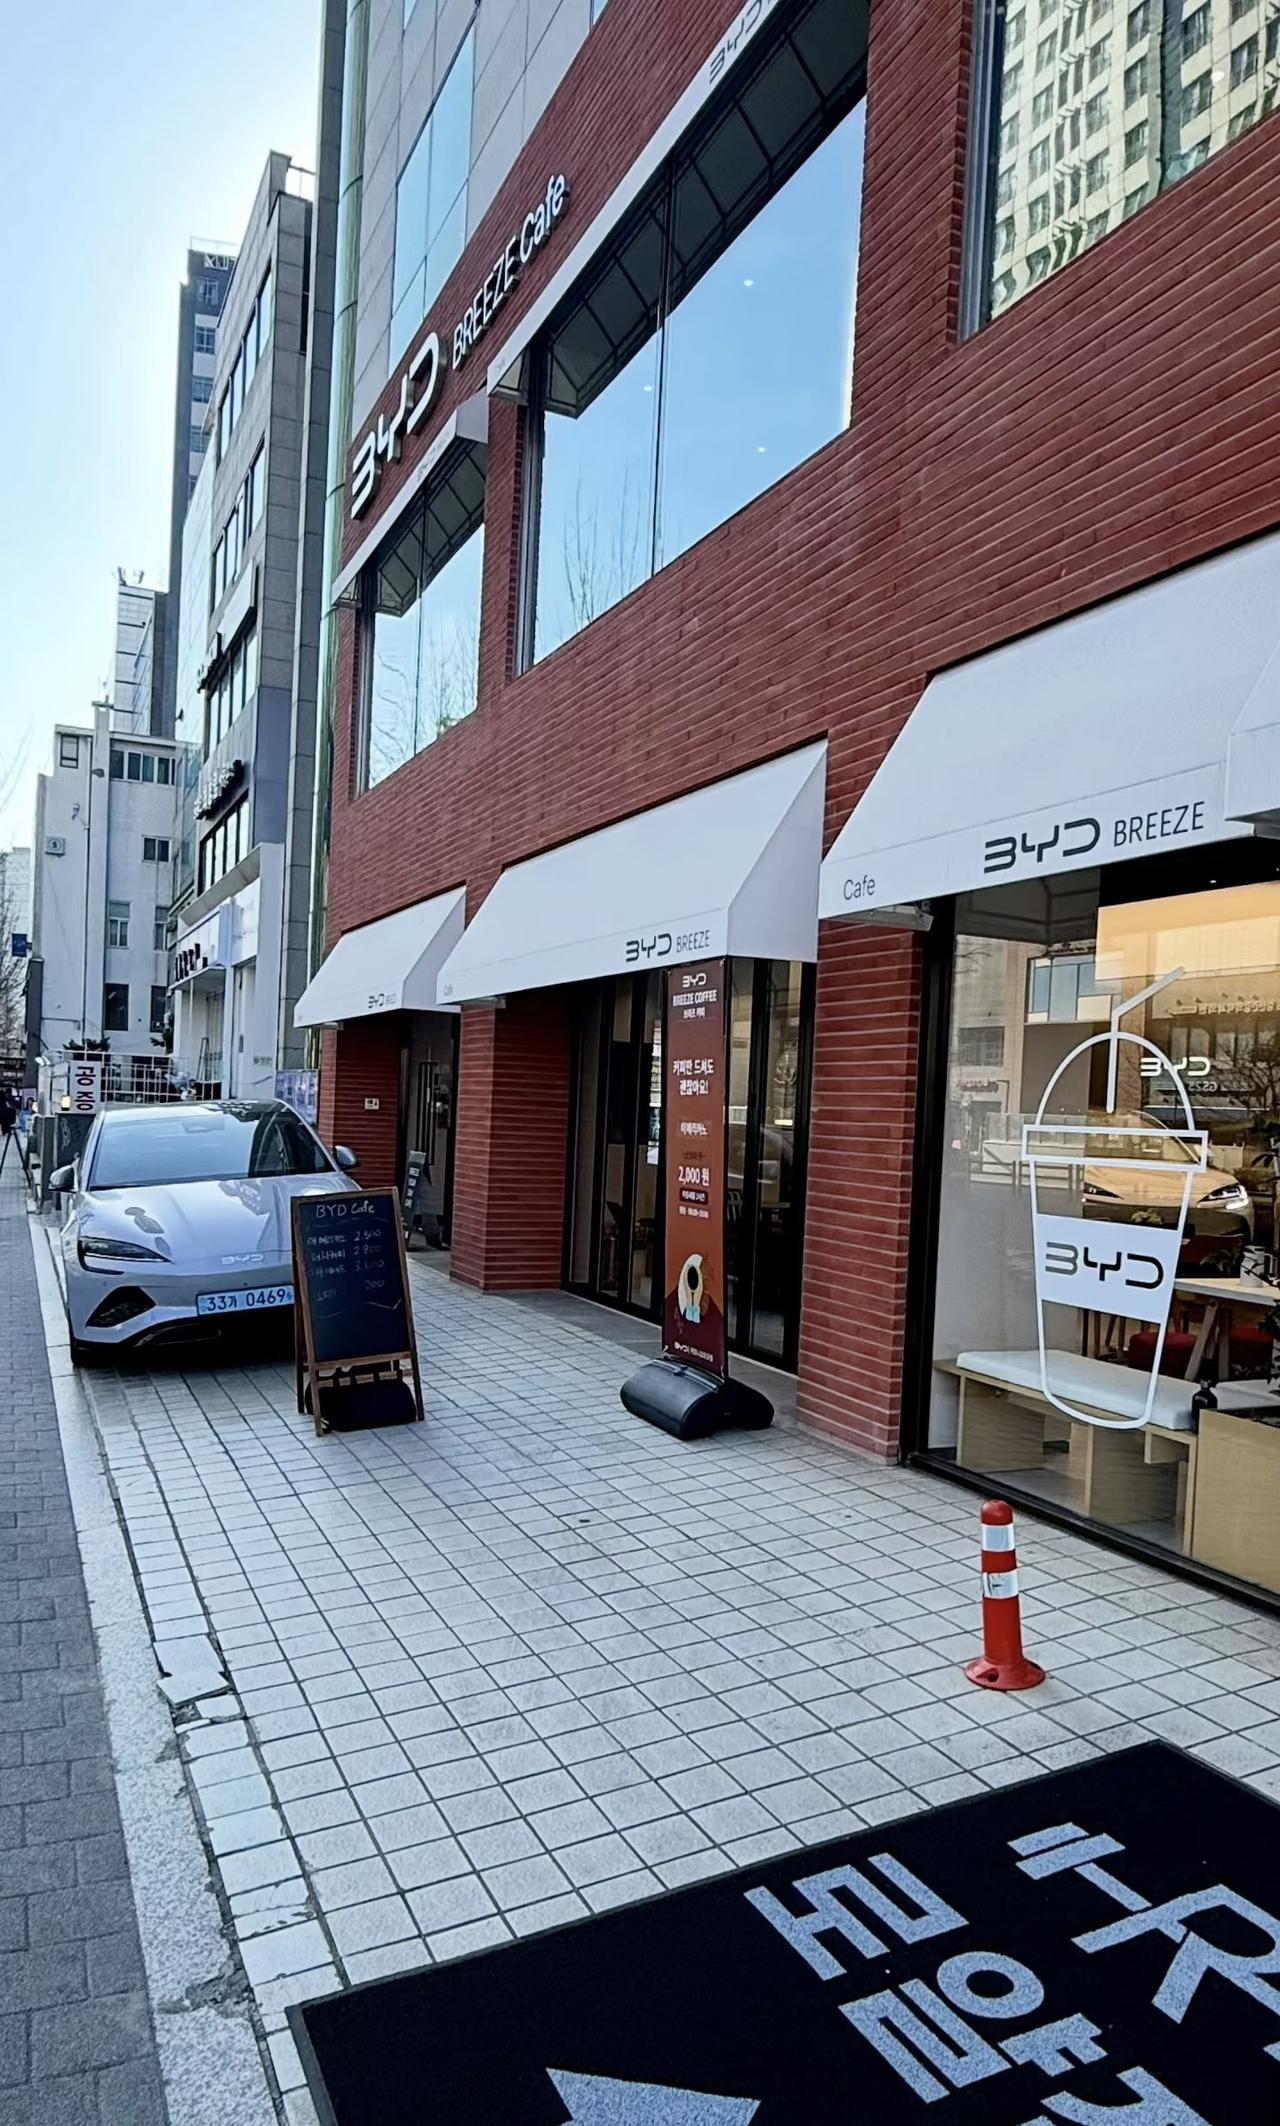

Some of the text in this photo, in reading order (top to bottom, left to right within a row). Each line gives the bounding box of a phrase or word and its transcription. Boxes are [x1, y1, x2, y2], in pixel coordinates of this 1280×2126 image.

[351, 174, 568, 519] BYD BREEZE Cafe
[843, 801, 1205, 902] Cafe BYD BREEZE
[626, 933, 673, 962] BYD
[676, 930, 711, 953] BREEZE
[682, 973, 707, 988] BYD
[694, 989, 717, 1004] COFFEE
[672, 1058, 714, 1076] 커피만 드셔도
[679, 1080, 709, 1096] 괜찮아요!
[678, 1165, 710, 1187] 2,000 원
[315, 1200, 375, 1218] BYD Cafe
[1045, 1241, 1165, 1290] BYD
[206, 1288, 286, 1312] 33가 0469
